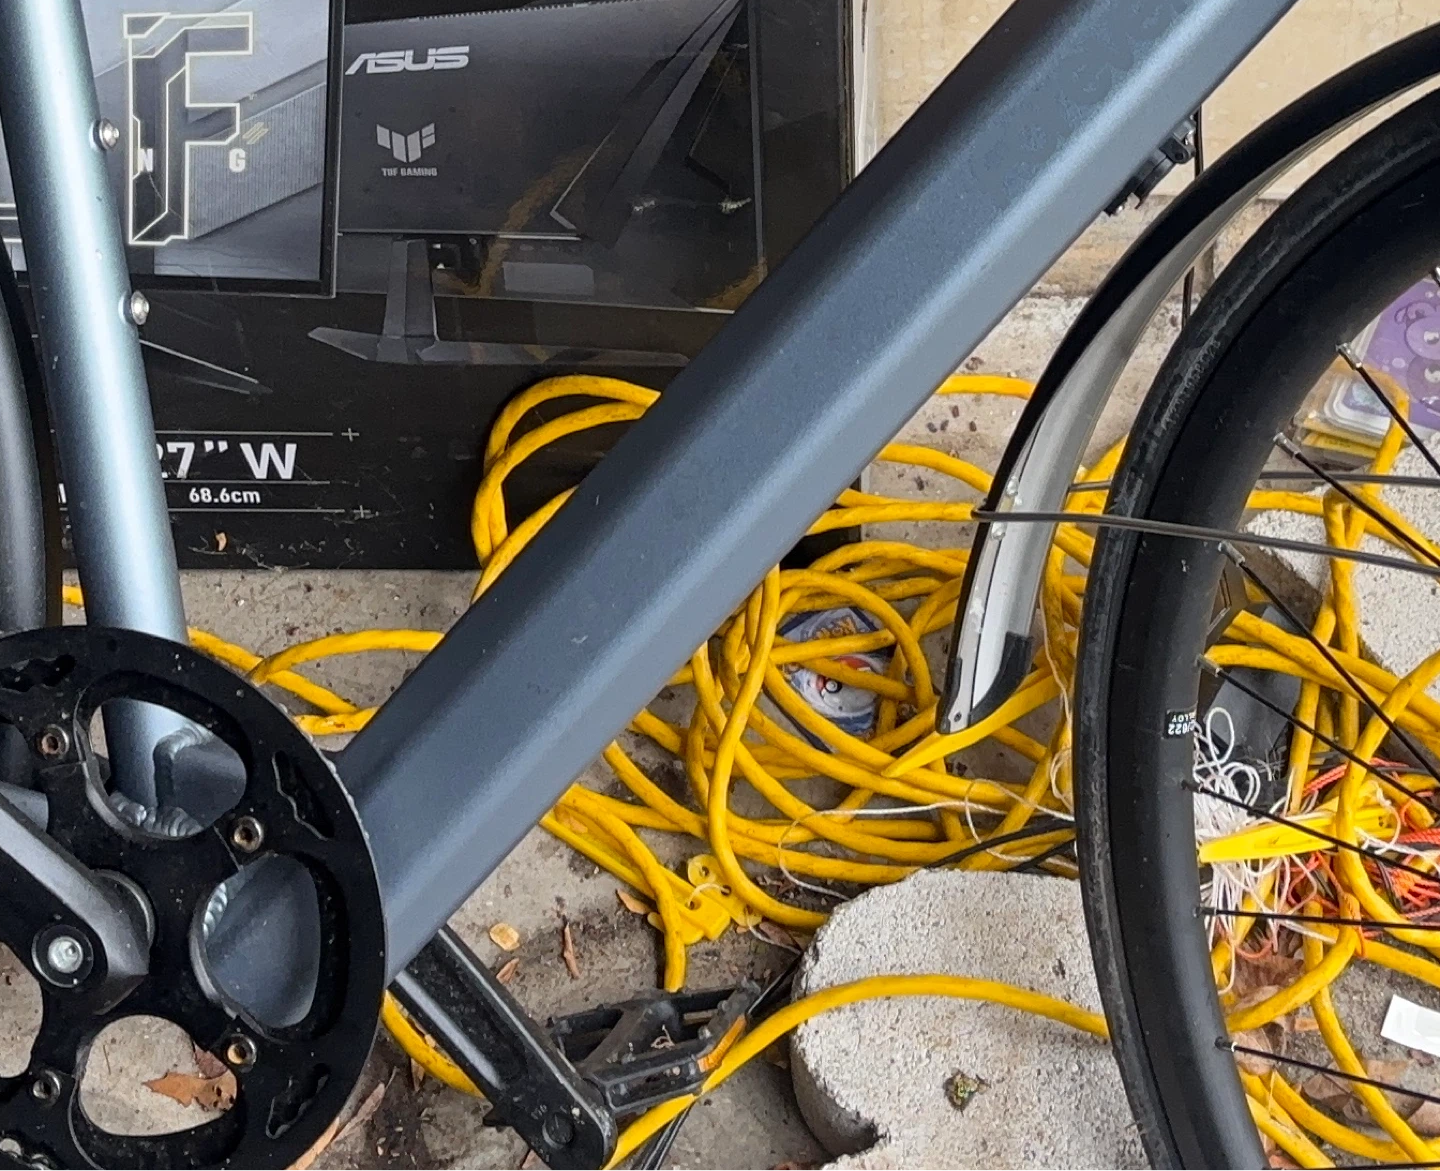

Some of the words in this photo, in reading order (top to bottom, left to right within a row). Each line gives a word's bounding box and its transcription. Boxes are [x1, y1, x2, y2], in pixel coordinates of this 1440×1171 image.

[344, 45, 470, 75] ASUS
[240, 442, 298, 480] W
[188, 487, 261, 504] 68.6cm
